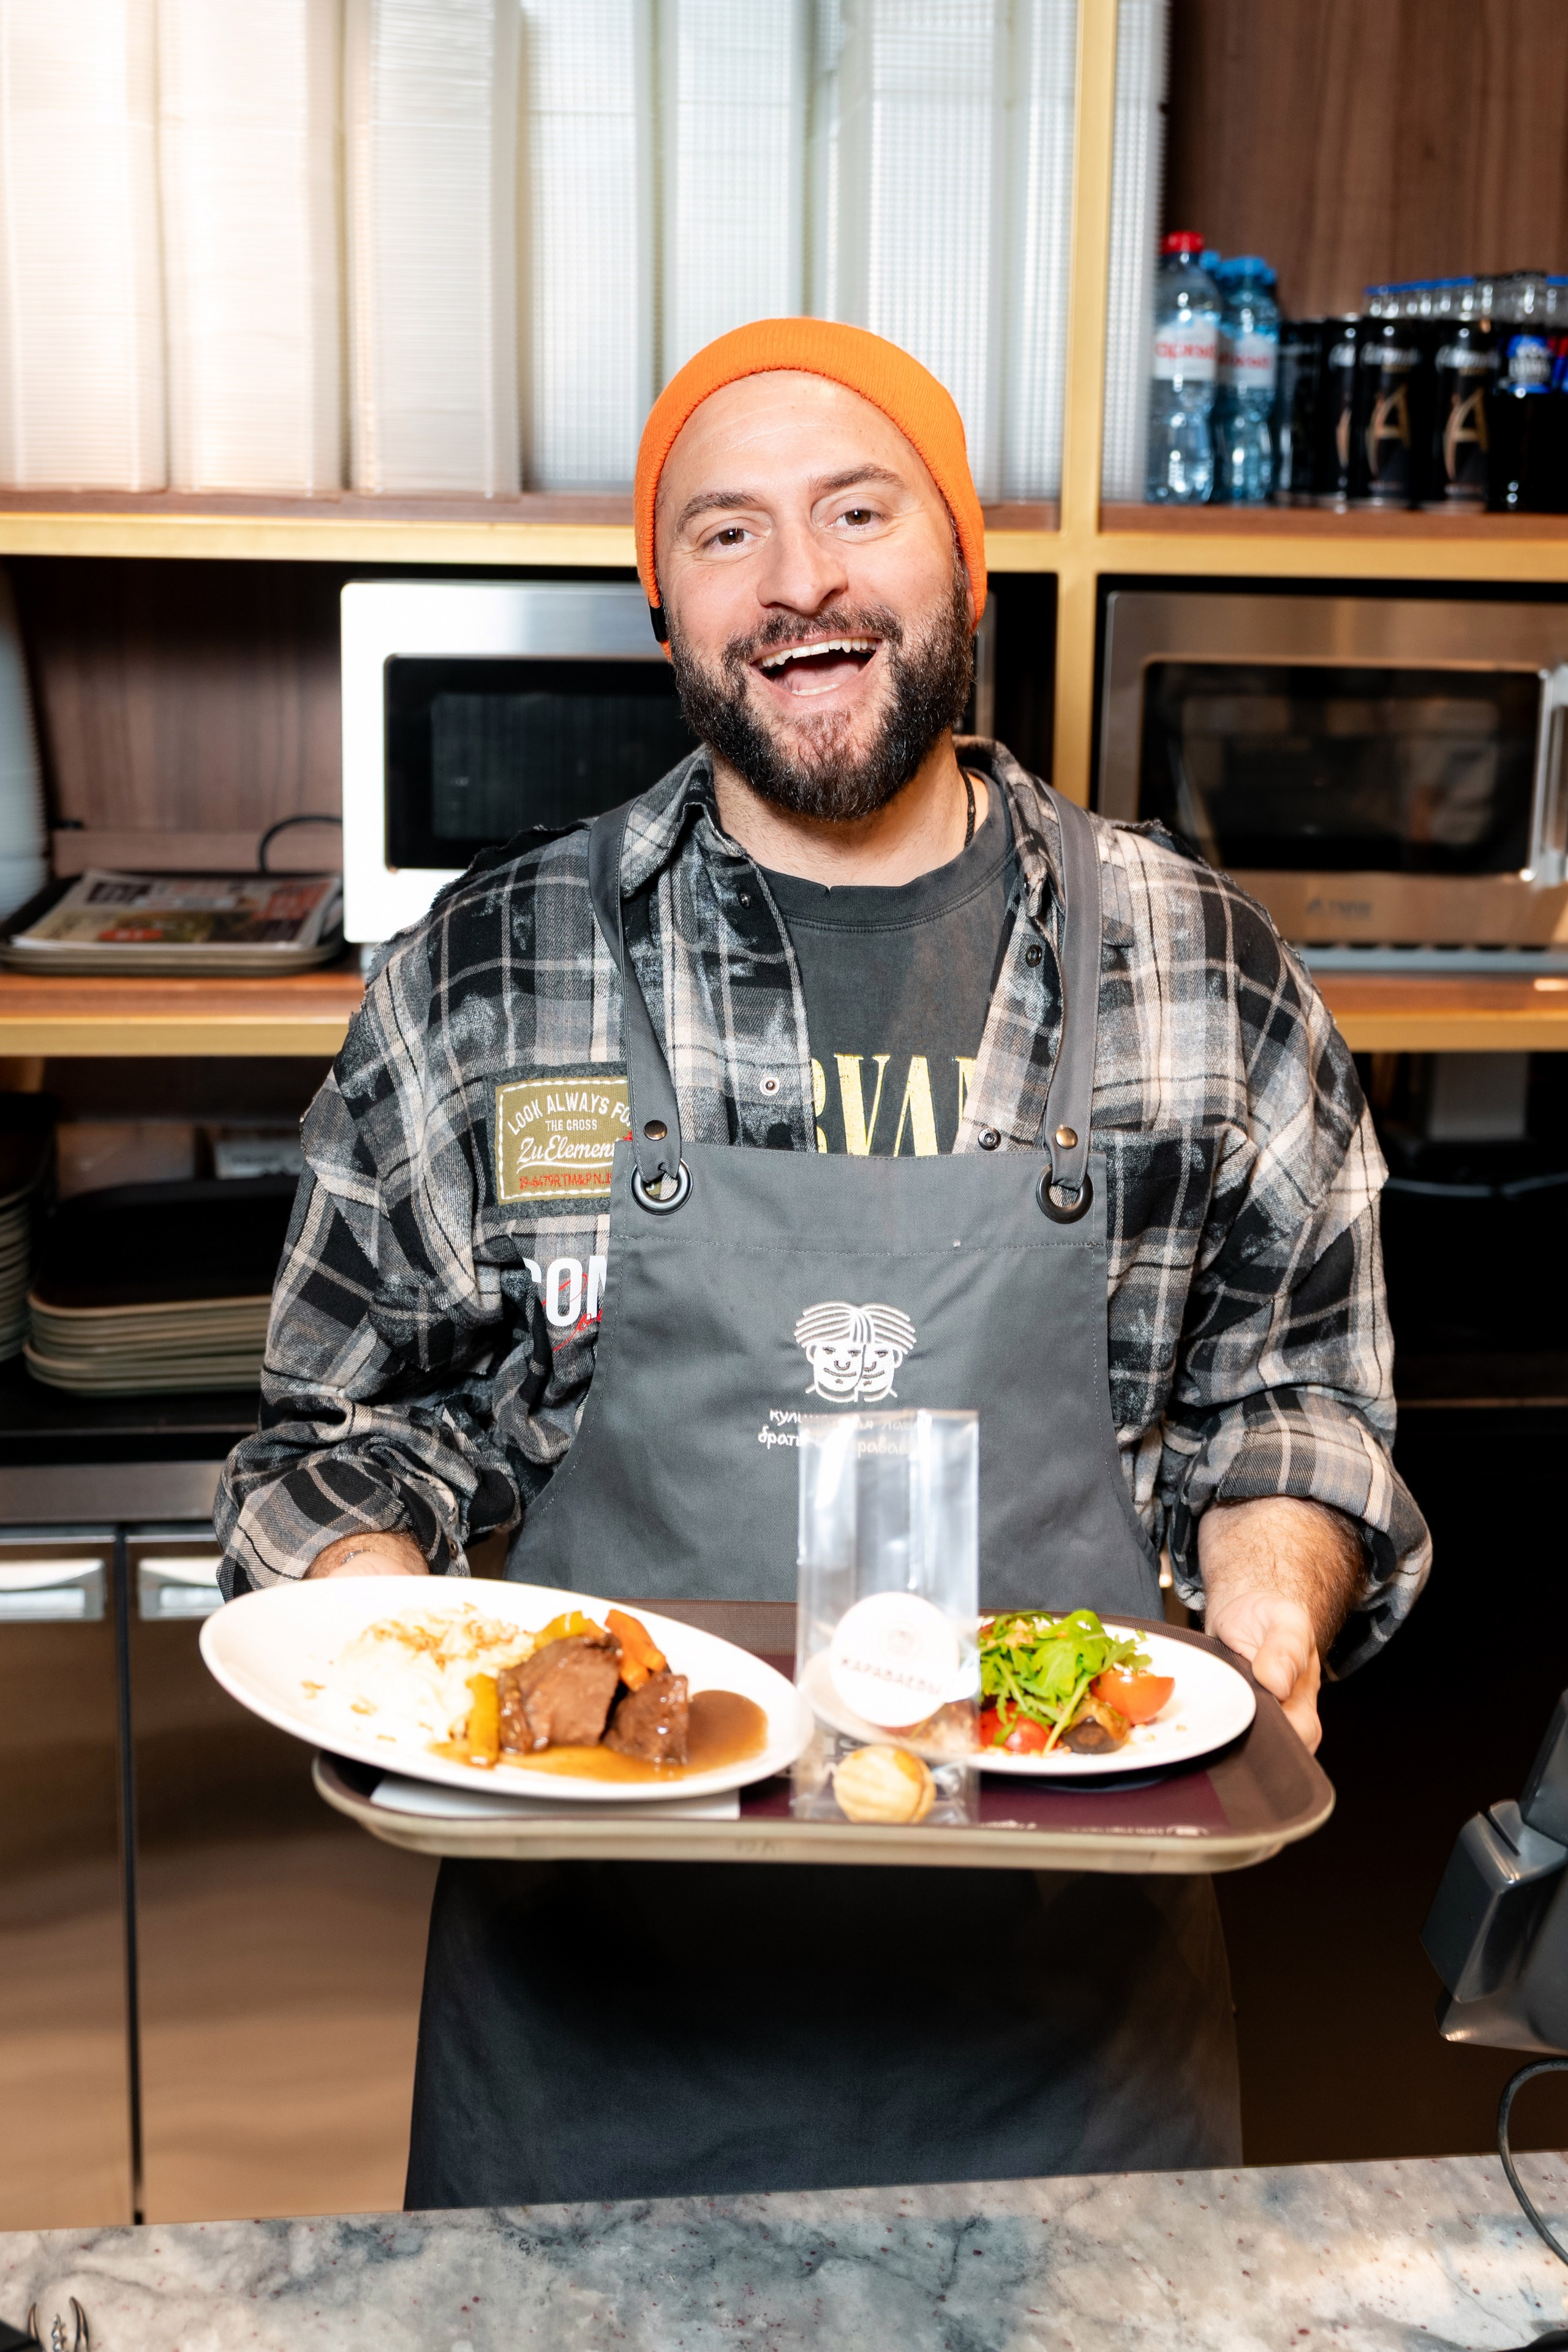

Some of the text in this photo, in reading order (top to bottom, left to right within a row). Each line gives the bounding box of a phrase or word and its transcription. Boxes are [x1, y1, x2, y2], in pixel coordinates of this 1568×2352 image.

[507, 1092, 631, 1136] LOOK ALWAYS FO
[545, 1119, 564, 1132] THE
